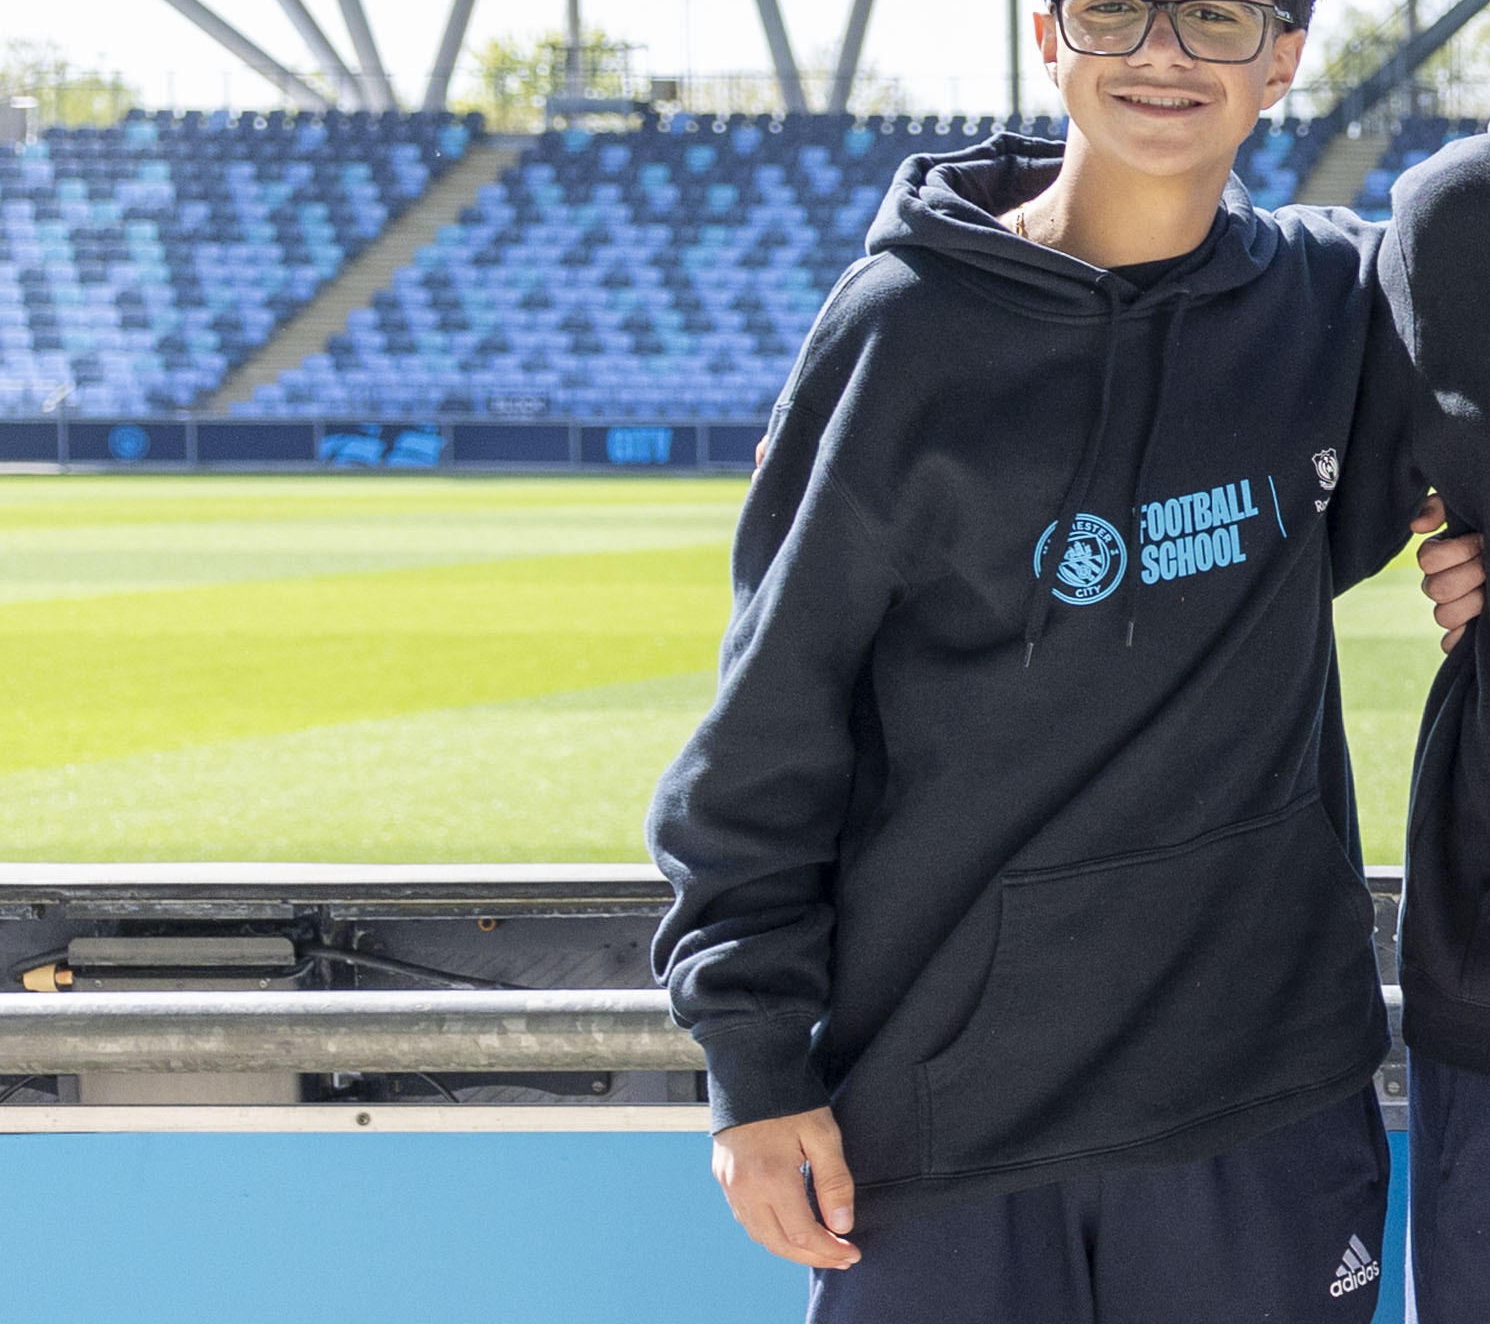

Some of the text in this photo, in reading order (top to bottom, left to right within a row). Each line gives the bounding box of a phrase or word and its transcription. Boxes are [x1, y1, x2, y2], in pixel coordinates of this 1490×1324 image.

[1140, 525, 1246, 585] SCHOOL
[1075, 584, 1103, 598] CITY
[1330, 1261, 1379, 1297] adidas
